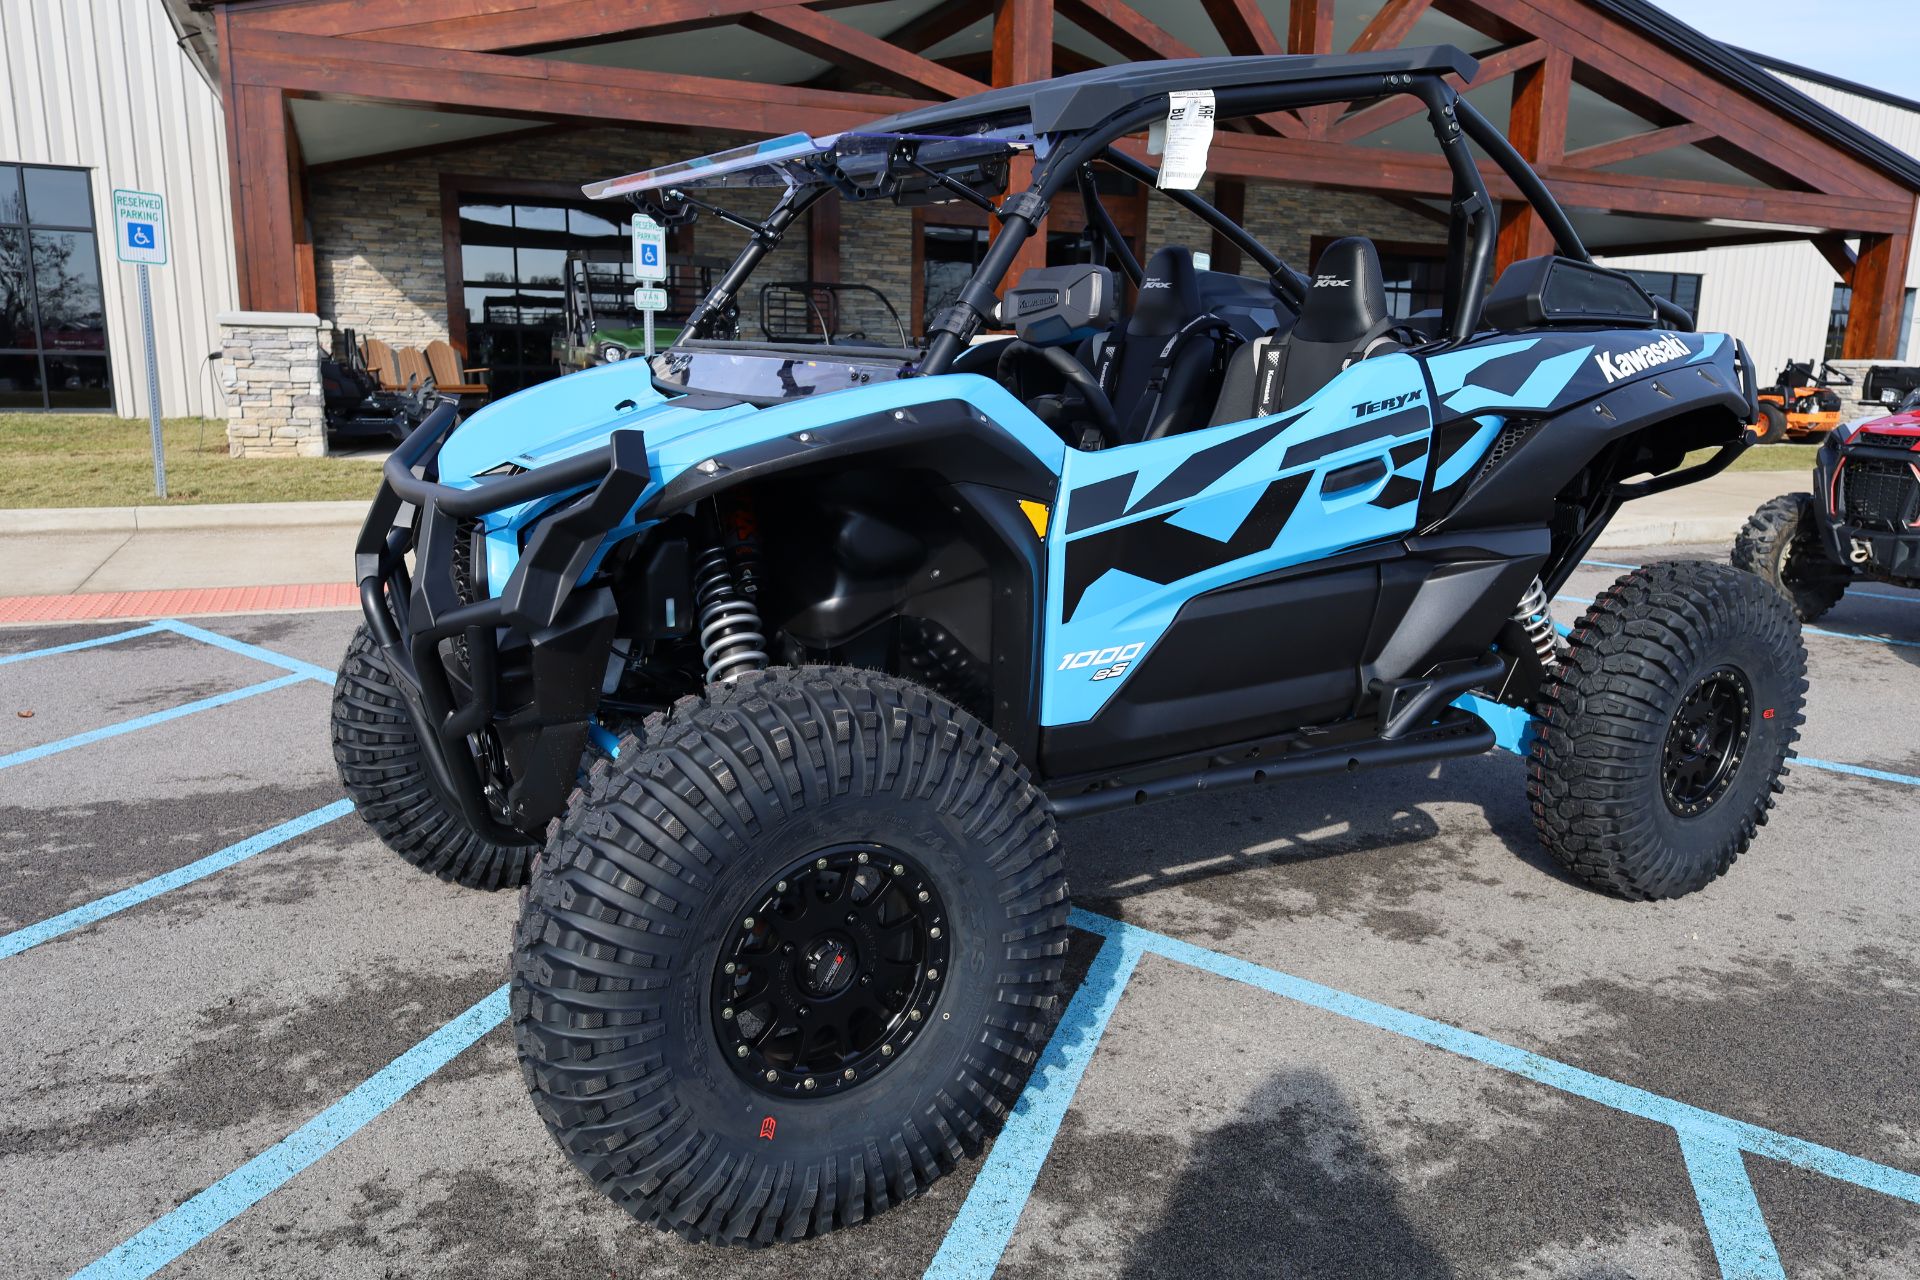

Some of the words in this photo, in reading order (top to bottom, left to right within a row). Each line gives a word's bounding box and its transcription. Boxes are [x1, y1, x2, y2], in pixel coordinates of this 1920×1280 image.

[1170, 108, 1185, 120] BU
[116, 195, 160, 210] RESERVED
[120, 208, 159, 222] PARKING
[1313, 279, 1352, 288] KRX
[643, 291, 660, 300] VAN
[1594, 333, 1692, 384] Kawasaki
[1263, 369, 1276, 404] Kawasaki
[1056, 641, 1146, 671] 1000
